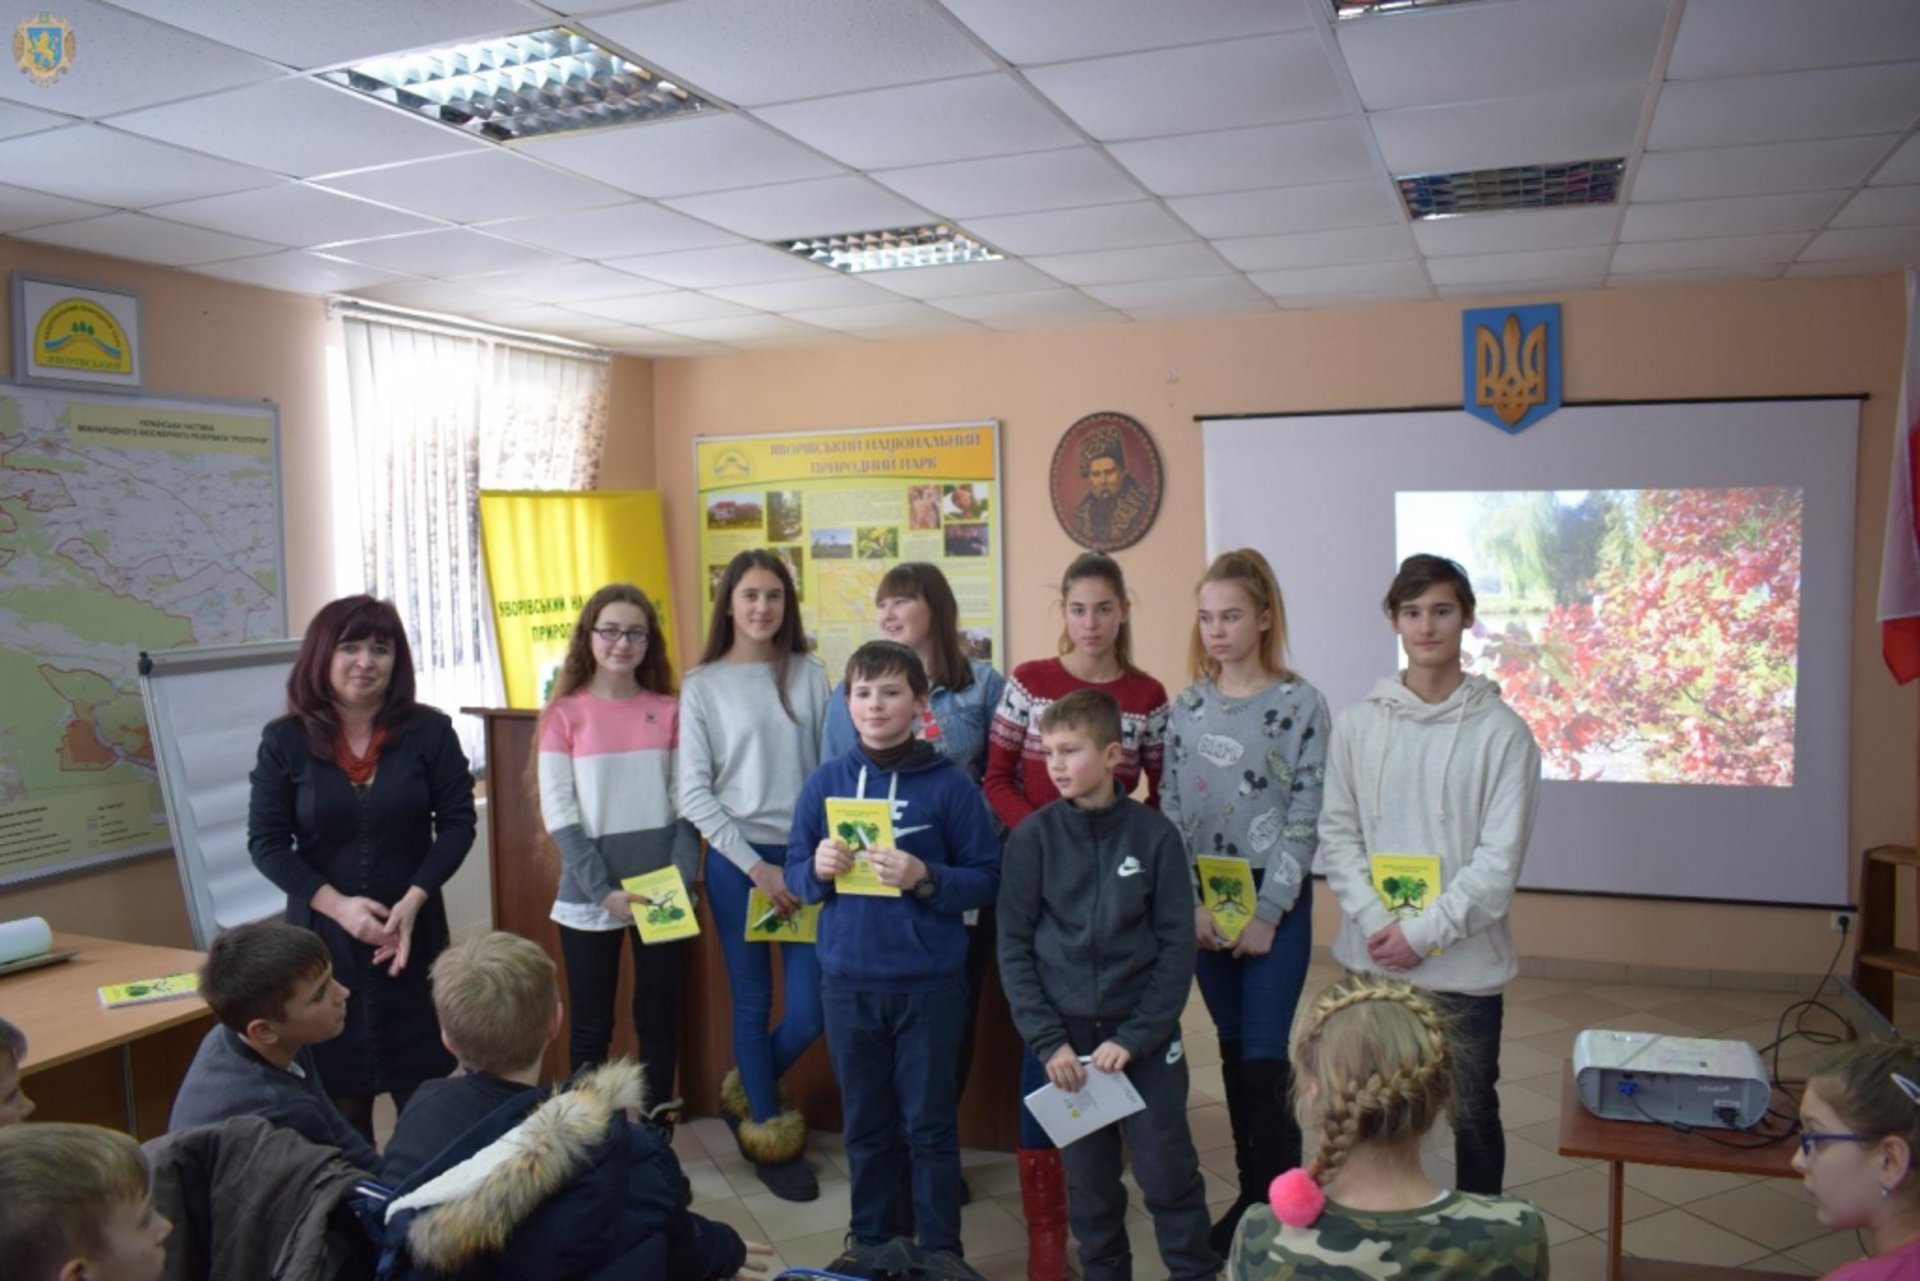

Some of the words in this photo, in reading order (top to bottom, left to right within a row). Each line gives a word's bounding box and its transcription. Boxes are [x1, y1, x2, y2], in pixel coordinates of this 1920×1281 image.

[770, 436, 862, 456] ЯВОРІВСЬКИЙ
[865, 431, 980, 453] НАЦІОНАЛЬНИЙ
[810, 453, 896, 474] ПРИРОДНИЙ
[899, 456, 938, 471] ПАРК
[498, 595, 566, 618] ЯВОРІВСЬКИЙ
